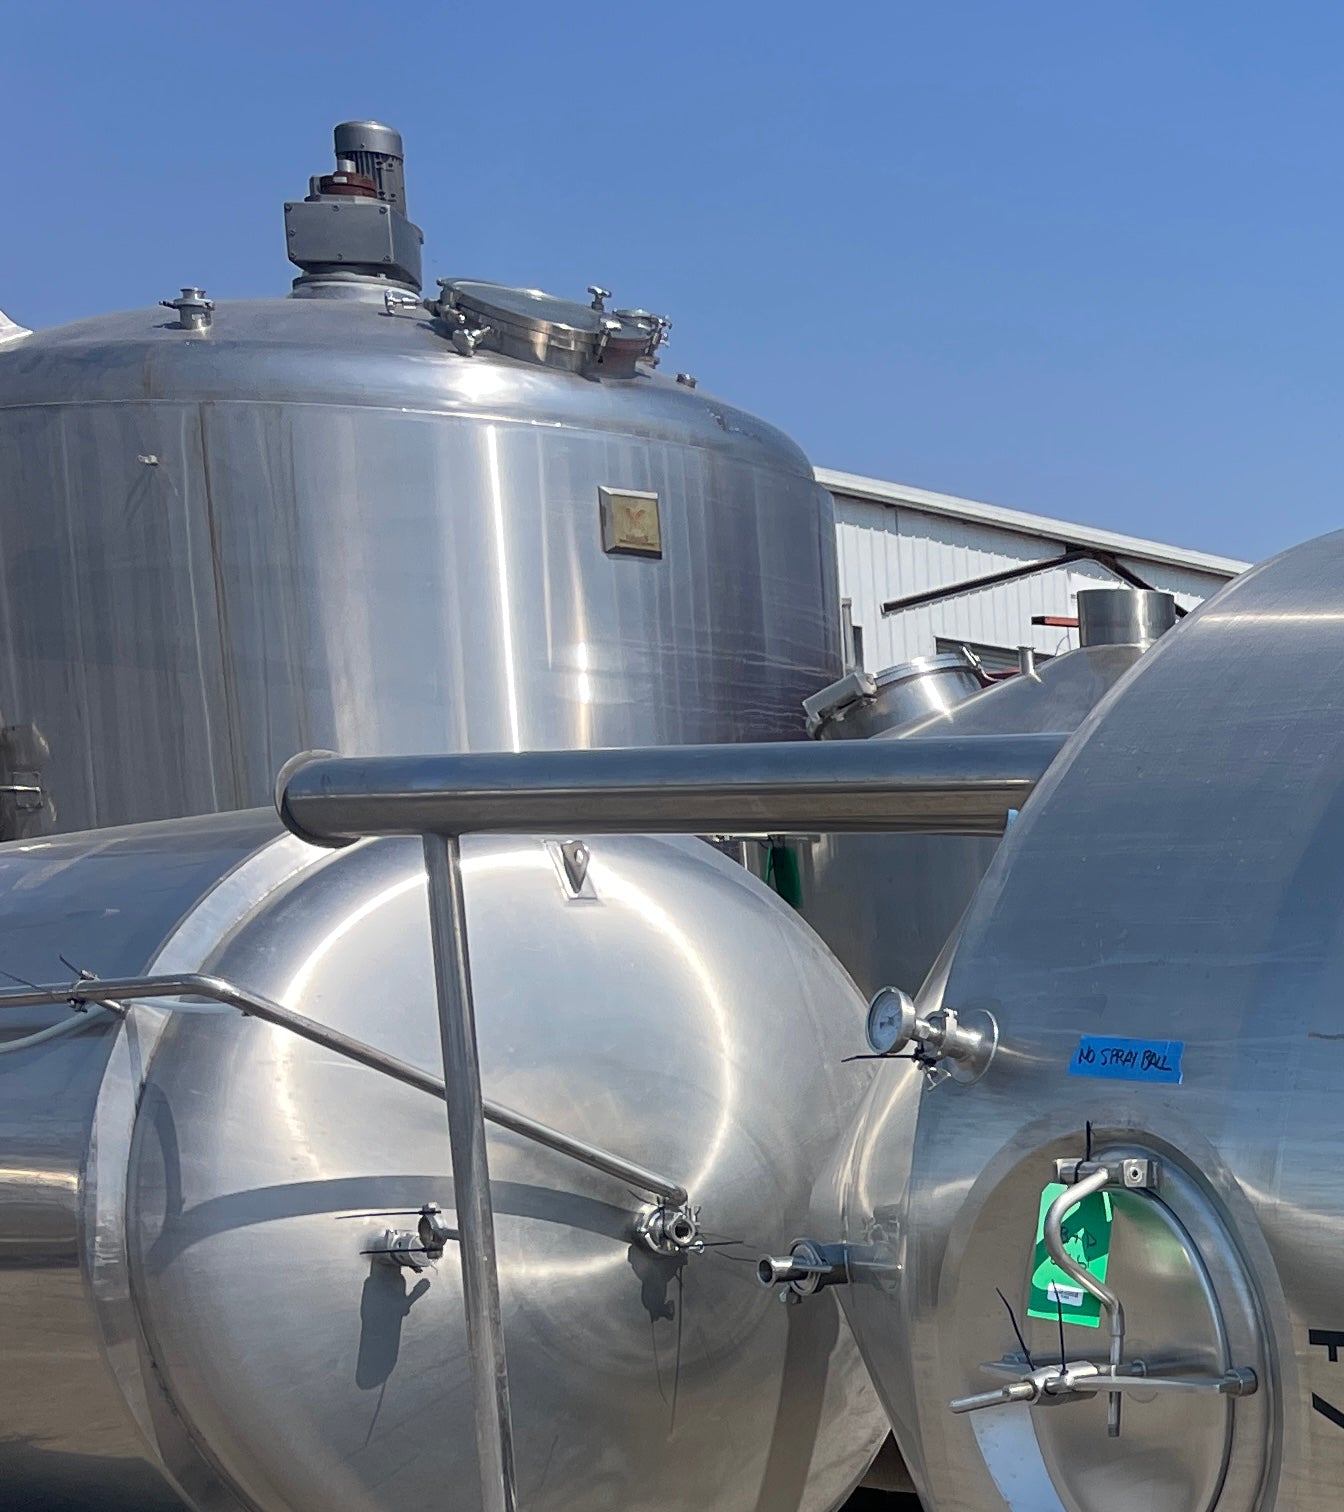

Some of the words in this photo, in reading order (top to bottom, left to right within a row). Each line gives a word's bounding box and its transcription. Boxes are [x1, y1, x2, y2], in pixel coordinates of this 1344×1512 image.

[1078, 1045, 1095, 1064] NO
[1101, 1047, 1138, 1069] SPRAY
[1140, 1049, 1172, 1072] BALL
